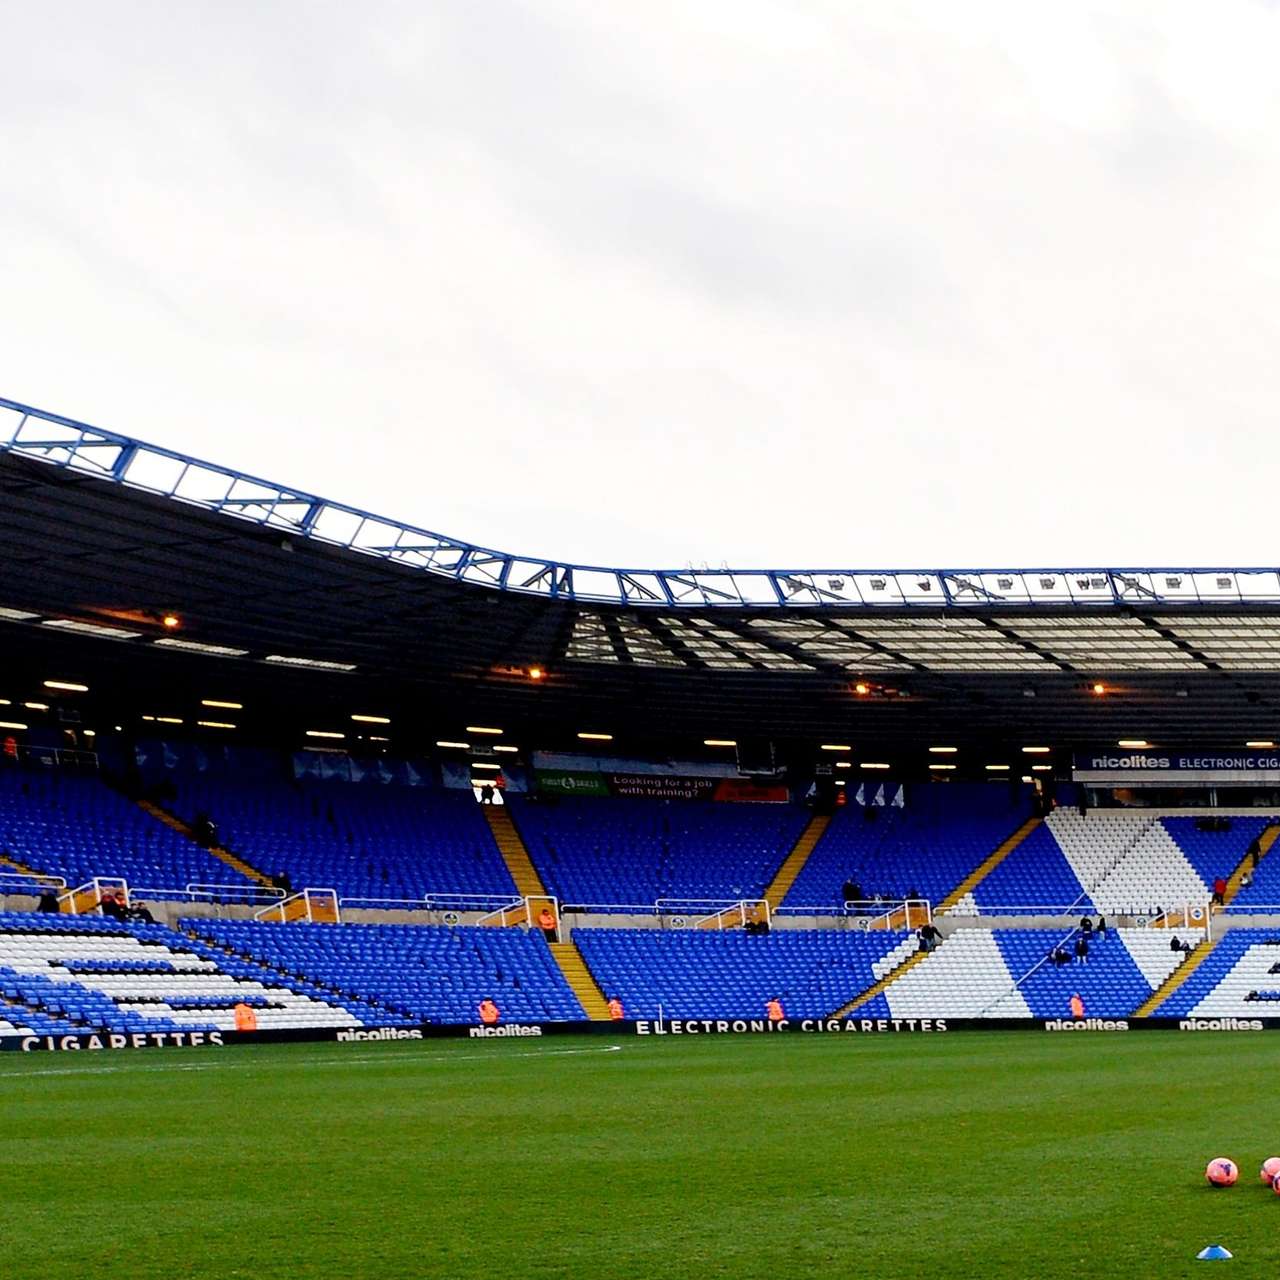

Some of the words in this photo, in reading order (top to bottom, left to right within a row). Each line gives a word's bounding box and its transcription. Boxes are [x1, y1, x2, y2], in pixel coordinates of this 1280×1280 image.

[1092, 755, 1170, 769] nicolites
[1179, 758, 1254, 768] ELECTRONIC
[613, 776, 662, 788] Looking
[619, 787, 645, 795] with
[647, 788, 700, 798] training?
[469, 1024, 542, 1037] nicolites
[636, 1019, 790, 1034] ELECTRONIC
[801, 1018, 947, 1033] CIGARETTES
[1045, 1018, 1129, 1031] nicolites
[1179, 1017, 1264, 1031] nicolites
[21, 1031, 224, 1051] CIGARETTES
[336, 1027, 423, 1042] nicolites
